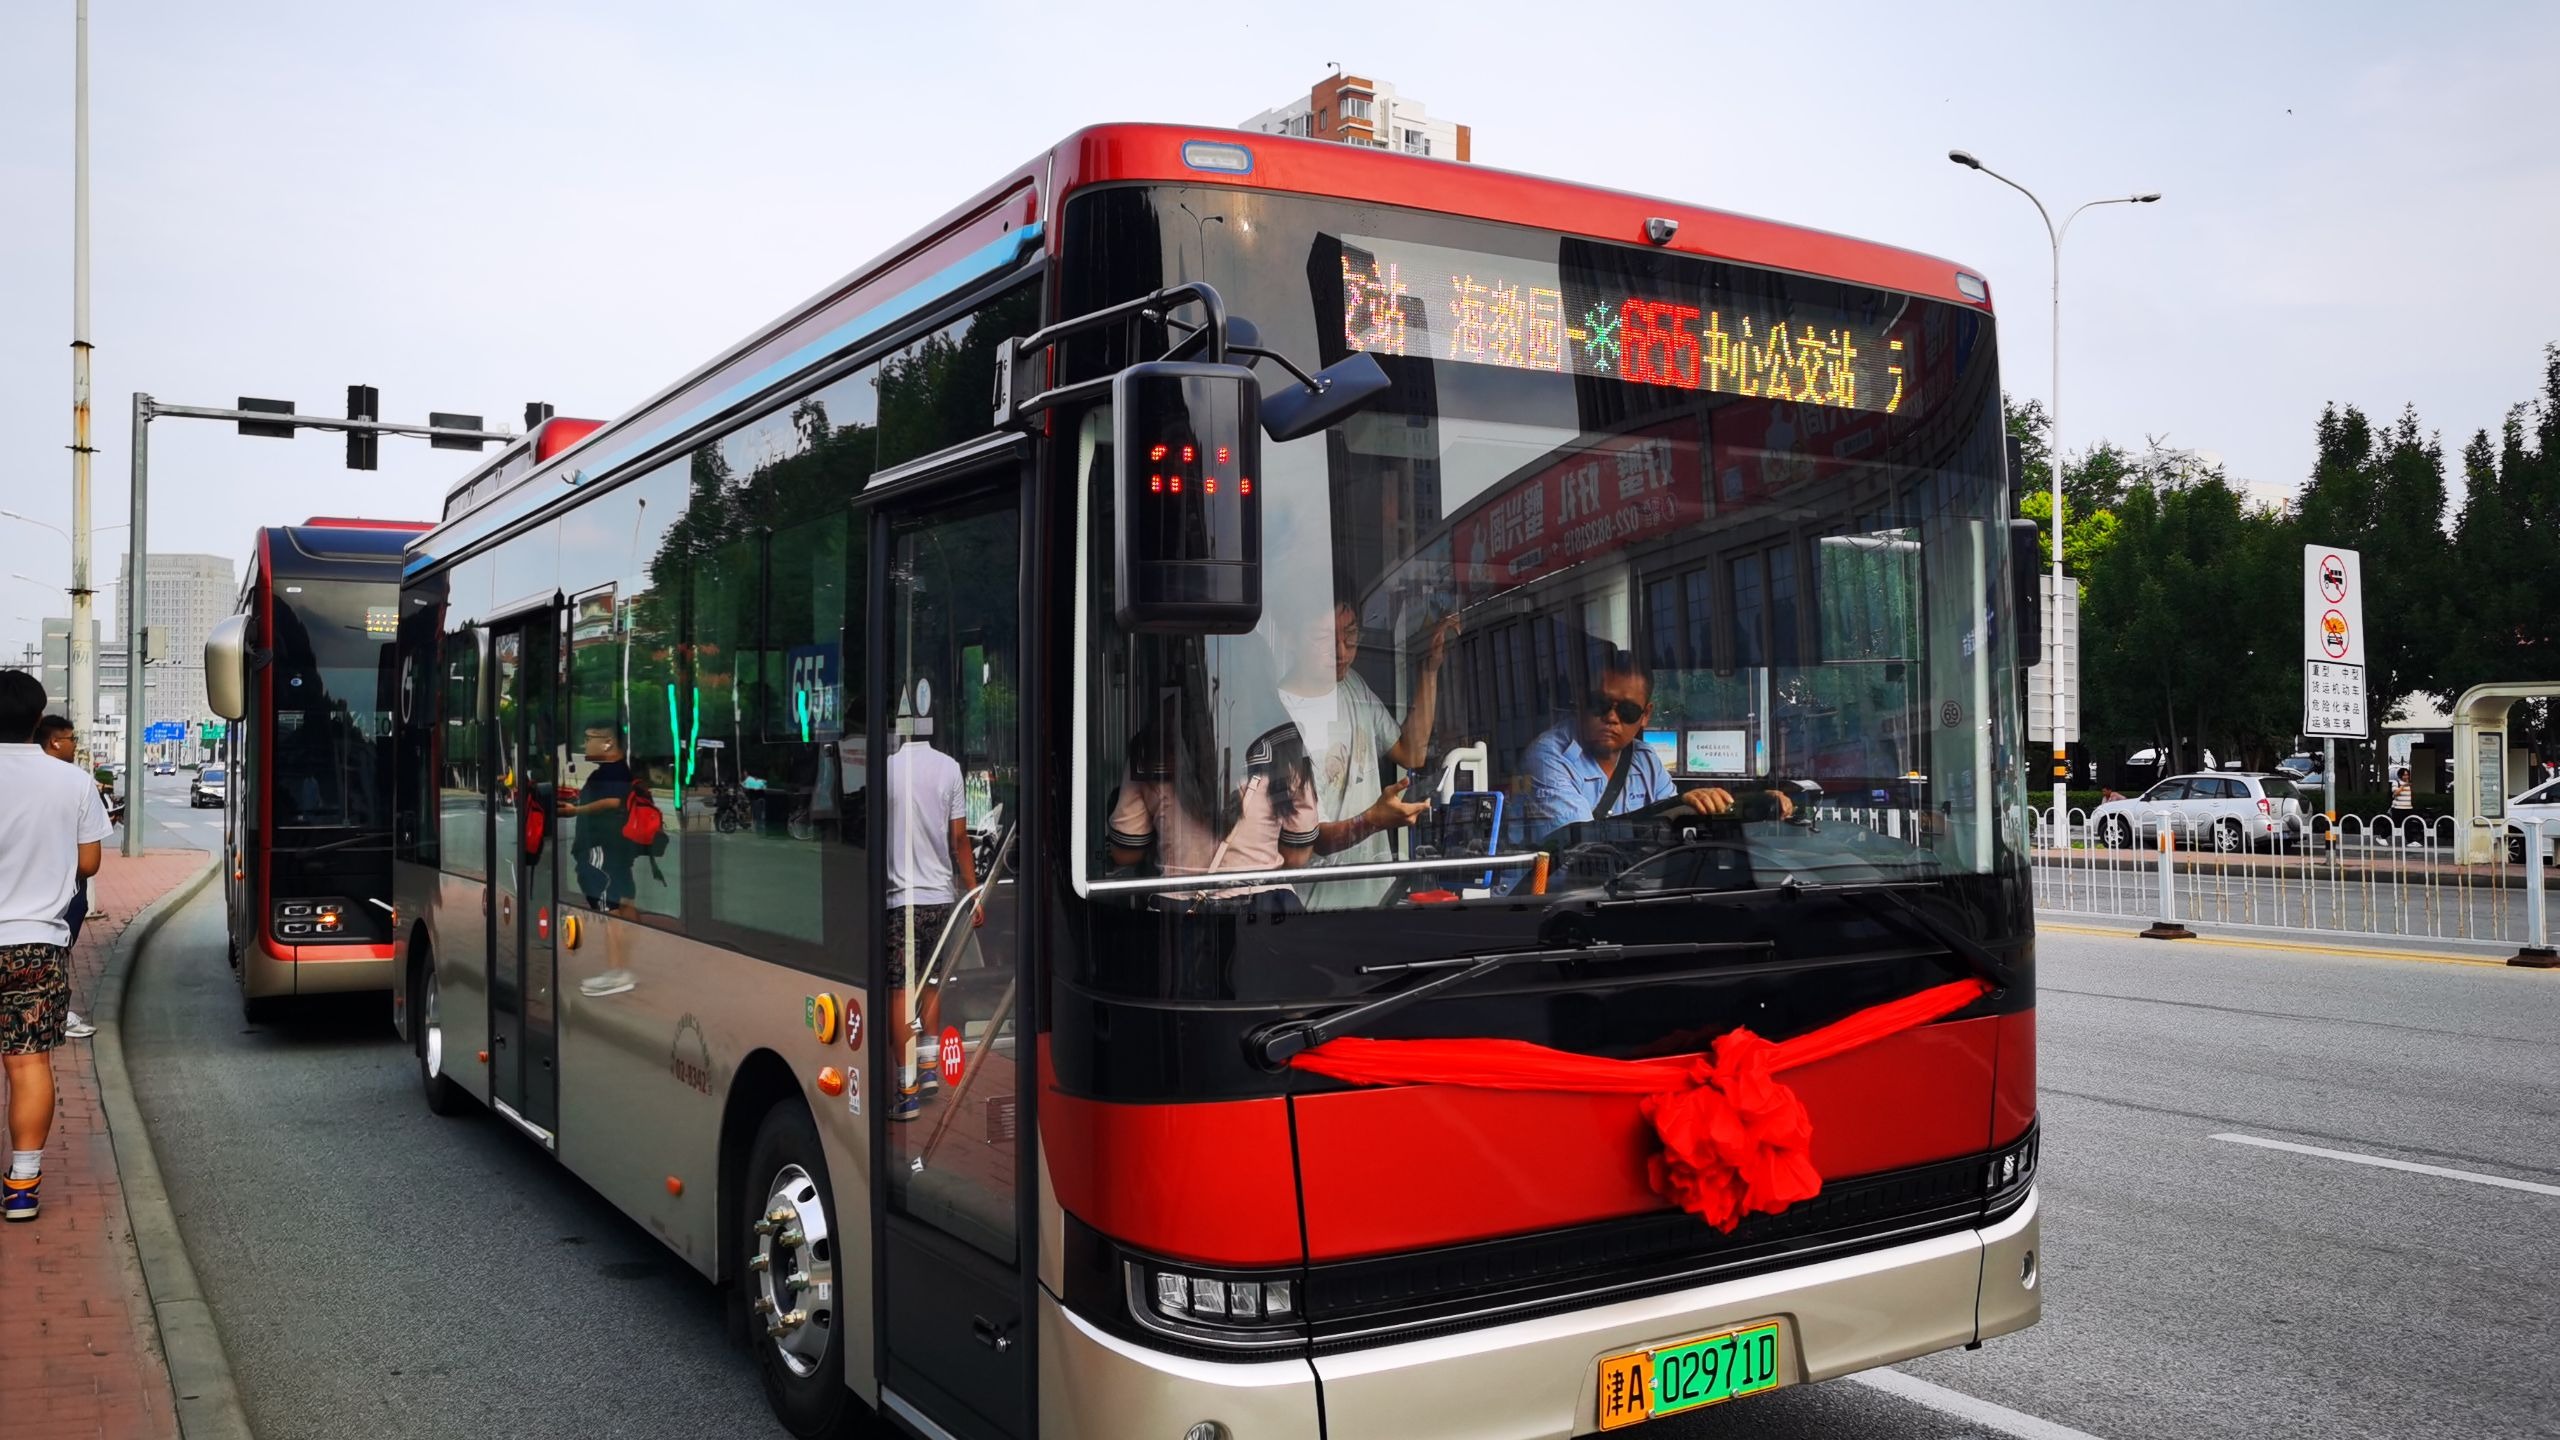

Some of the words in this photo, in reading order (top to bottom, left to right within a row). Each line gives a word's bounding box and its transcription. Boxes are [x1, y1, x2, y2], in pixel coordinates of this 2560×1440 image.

[1620, 297, 1700, 389] 655
[1703, 312, 1857, 409] 中心公交站
